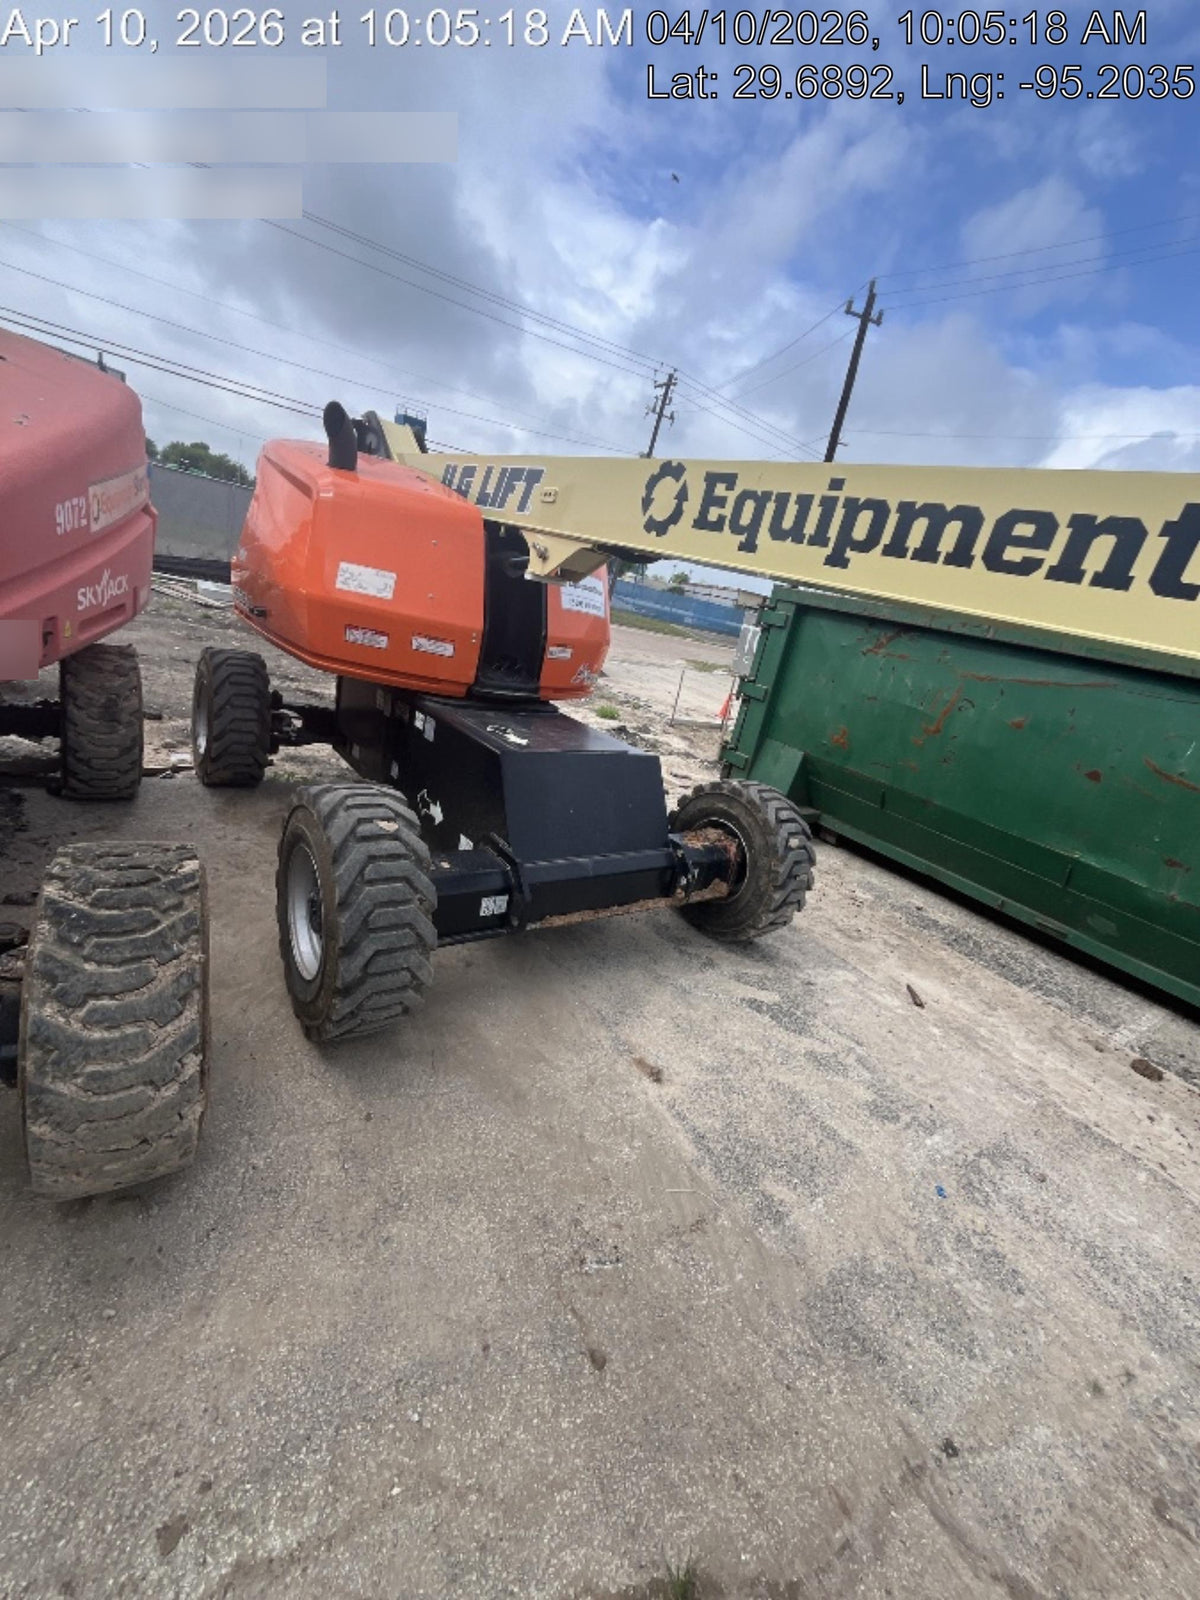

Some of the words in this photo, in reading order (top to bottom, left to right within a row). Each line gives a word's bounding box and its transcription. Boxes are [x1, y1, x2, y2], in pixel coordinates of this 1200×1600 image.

[474, 464, 546, 515] LIFT
[691, 471, 1200, 602] Equipment
[77, 568, 129, 611] SKYJACK
